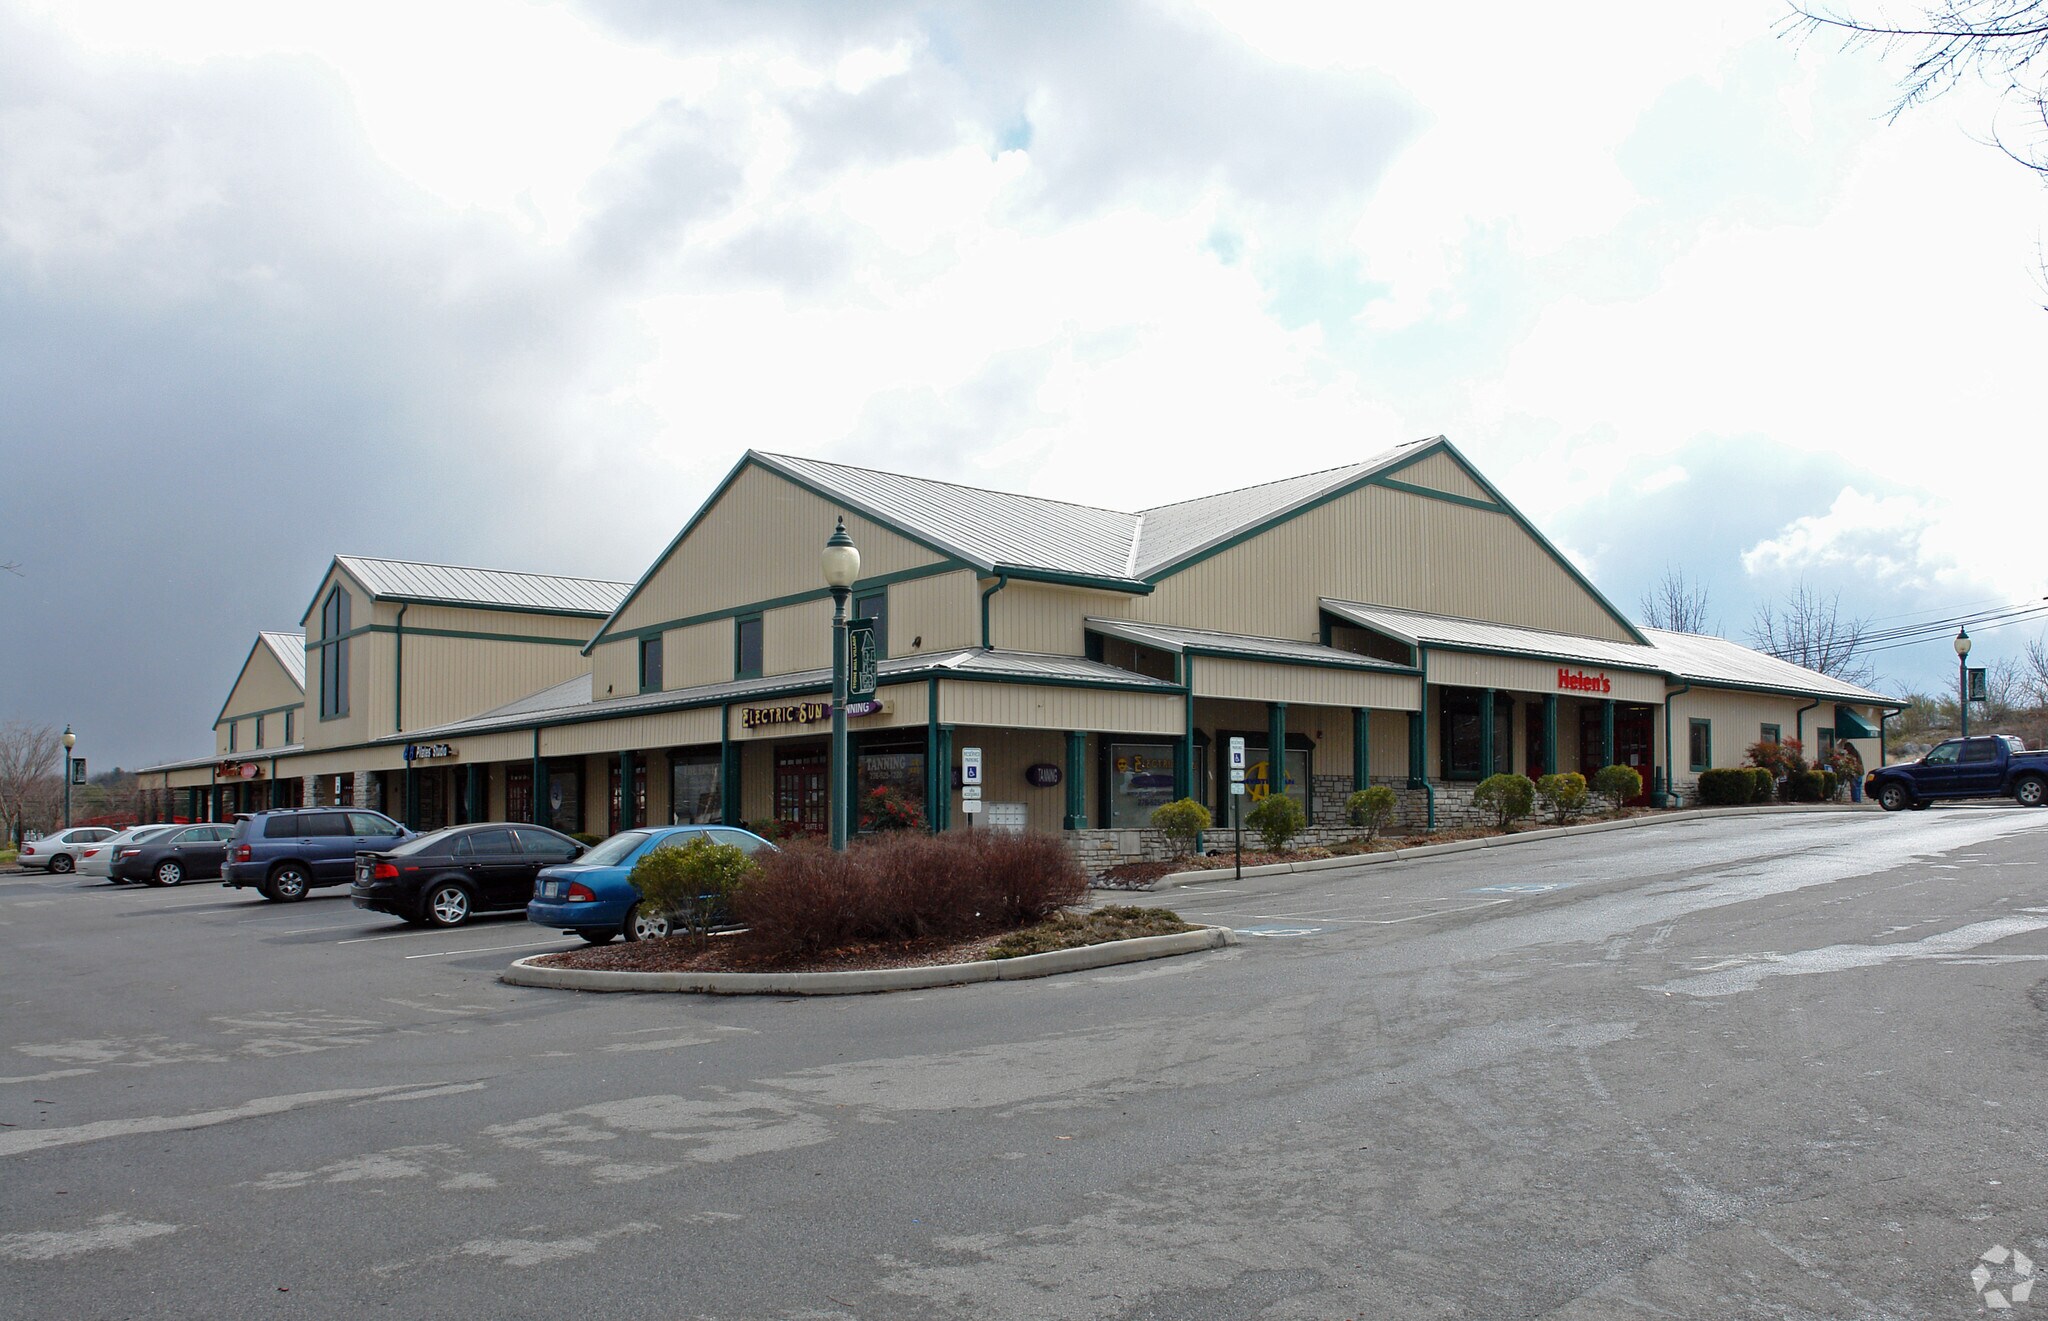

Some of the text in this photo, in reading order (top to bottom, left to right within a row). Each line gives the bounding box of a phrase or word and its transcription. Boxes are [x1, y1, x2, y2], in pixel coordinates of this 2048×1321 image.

[1558, 668, 1611, 693] Helen's
[742, 703, 823, 728] ELECTRIC SUN
[846, 702, 870, 714] NNING
[866, 756, 906, 771] TANNING
[1038, 768, 1057, 783] TANNING
